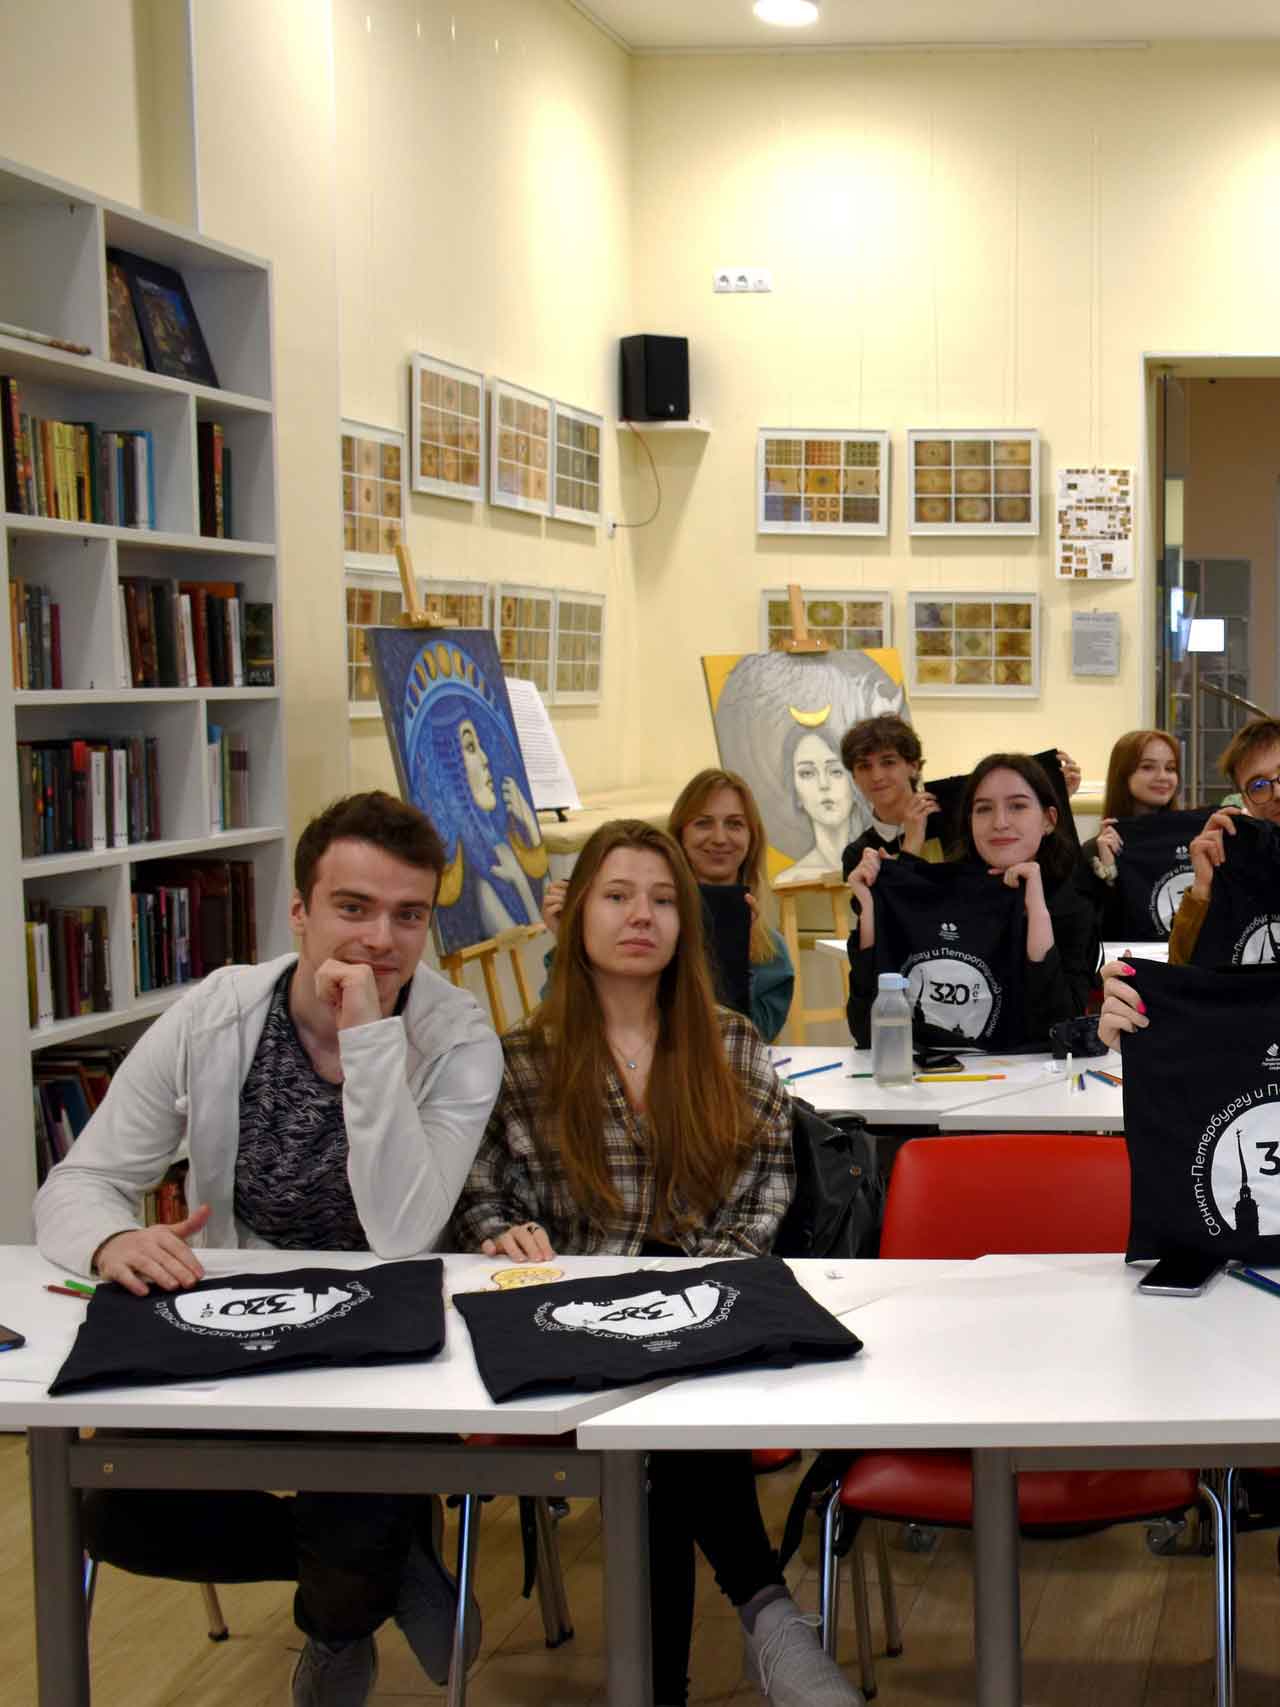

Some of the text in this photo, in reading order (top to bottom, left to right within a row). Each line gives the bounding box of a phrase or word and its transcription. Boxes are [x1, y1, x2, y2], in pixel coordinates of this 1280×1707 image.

[929, 981, 970, 1006] 320
[1191, 1093, 1252, 1237] Санкт-Петербургу
[1255, 1088, 1264, 1099] и
[219, 1293, 296, 1316] 320
